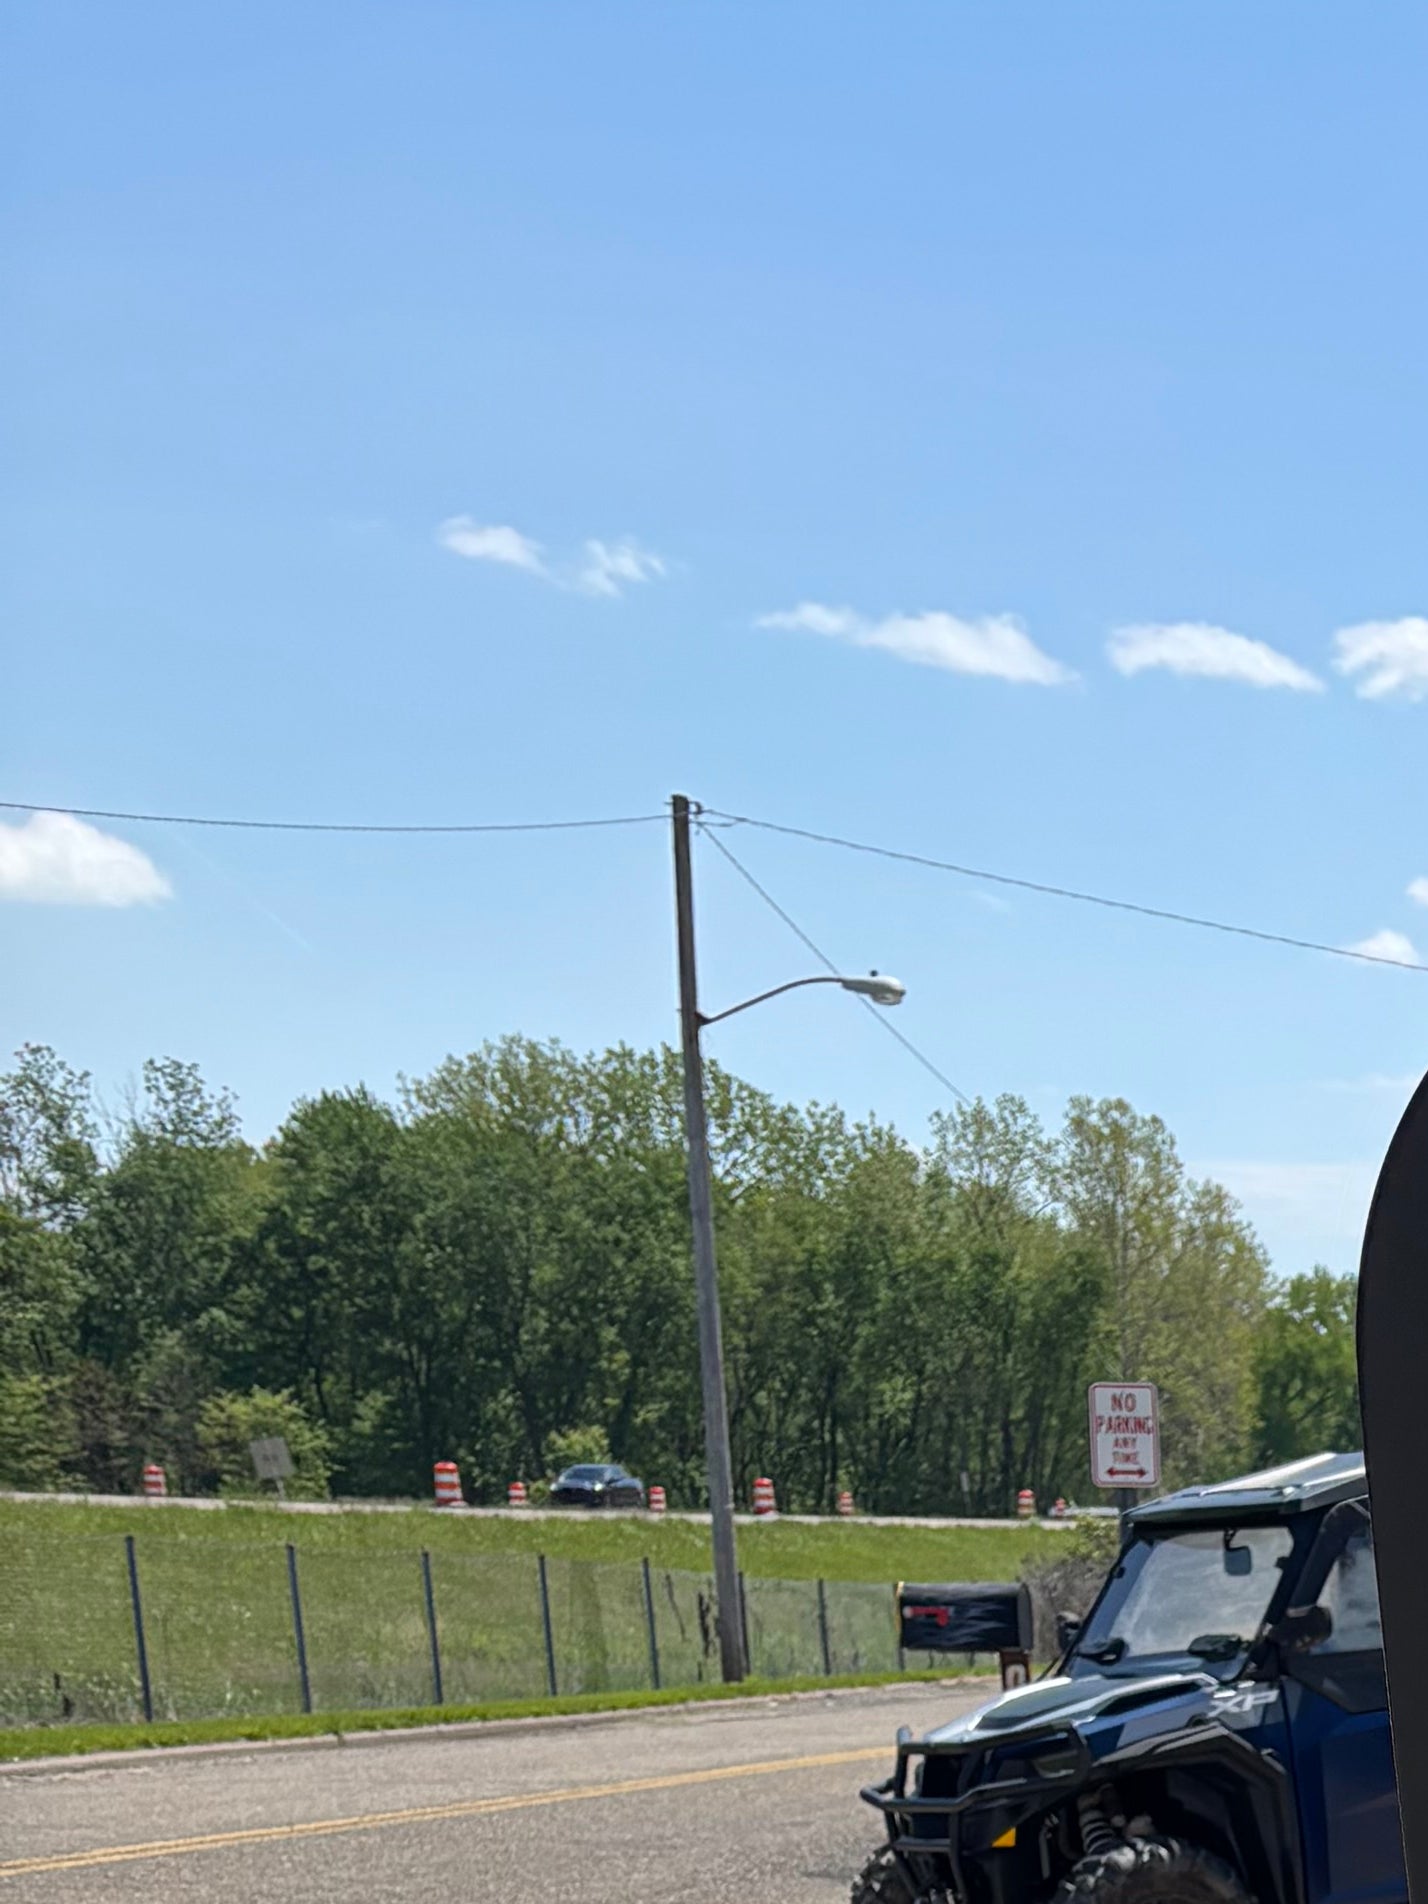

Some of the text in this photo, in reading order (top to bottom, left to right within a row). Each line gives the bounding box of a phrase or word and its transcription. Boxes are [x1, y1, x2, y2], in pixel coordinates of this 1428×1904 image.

[1111, 1392, 1136, 1412] NO
[1096, 1416, 1153, 1435] PARKING
[1207, 1689, 1280, 1718] XP
